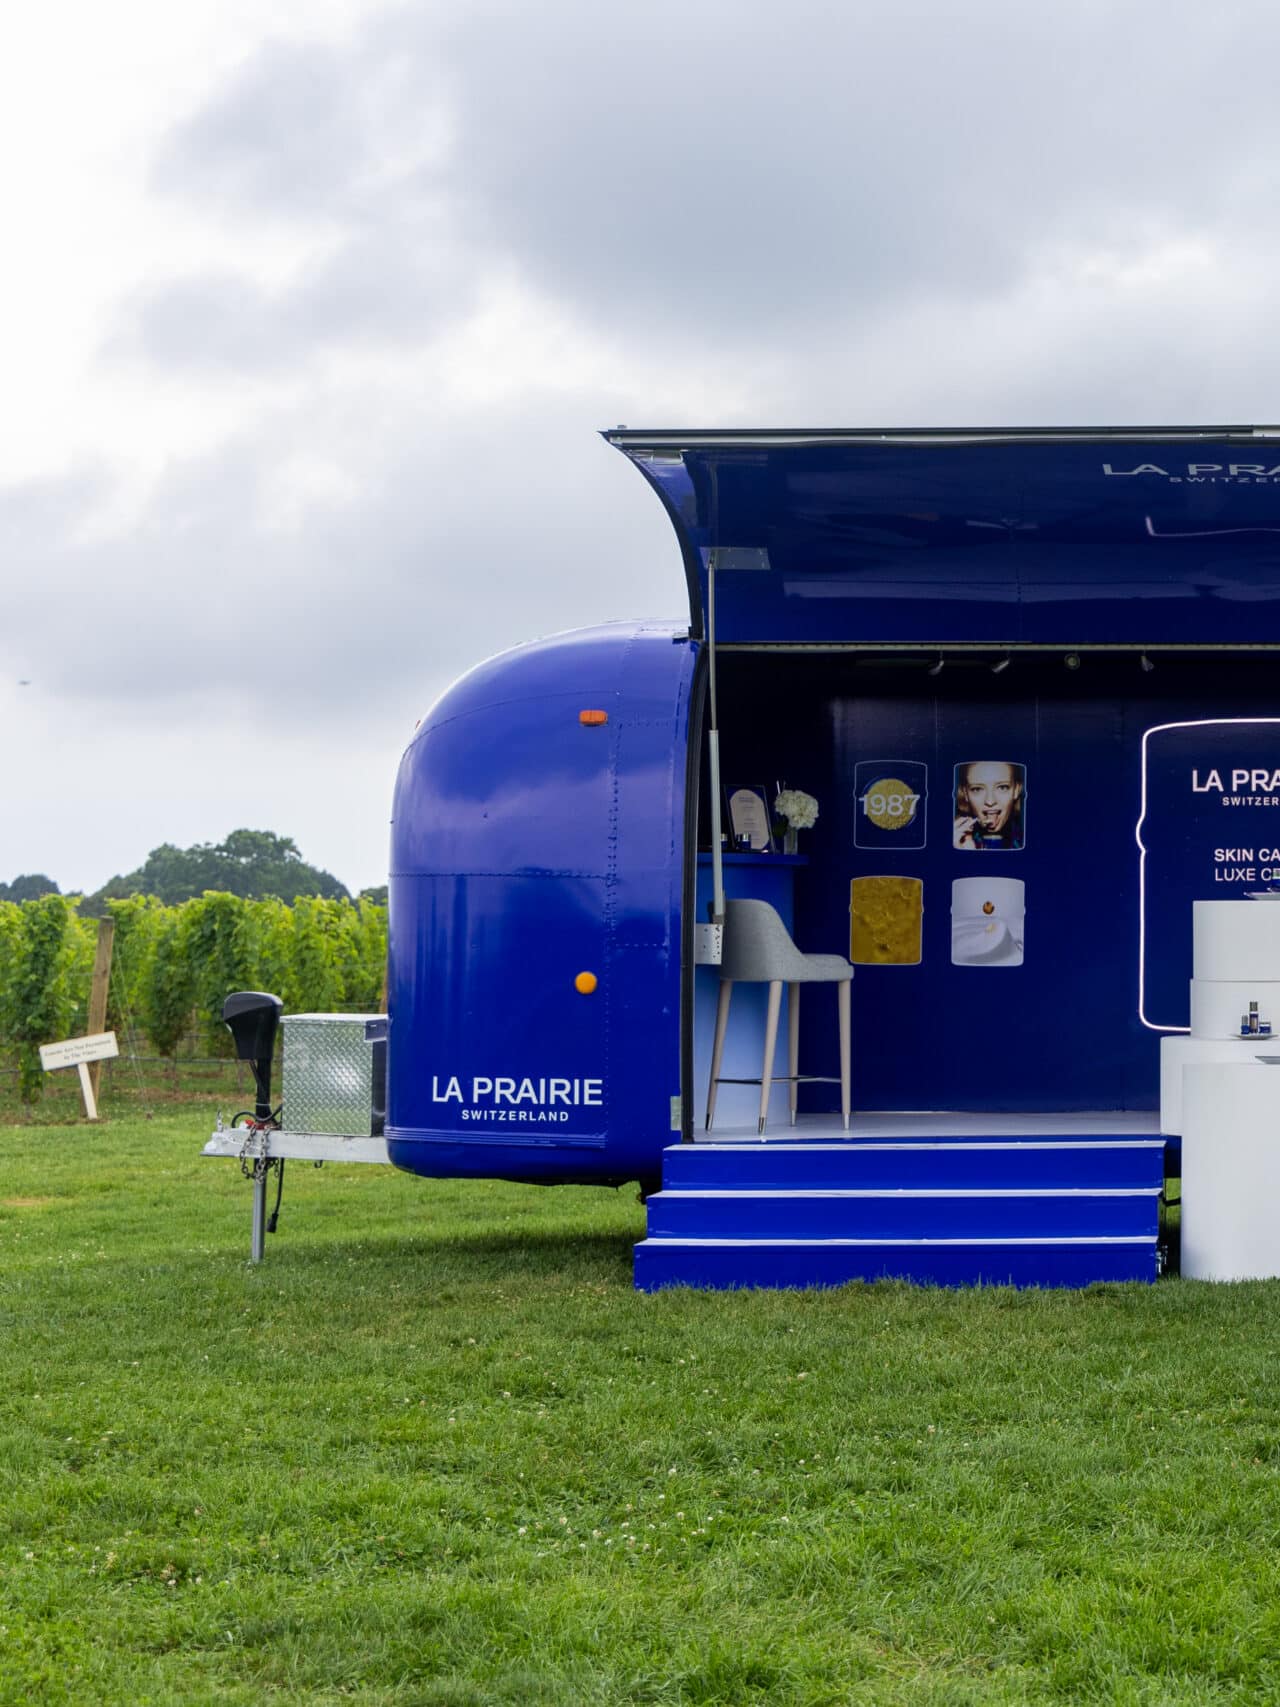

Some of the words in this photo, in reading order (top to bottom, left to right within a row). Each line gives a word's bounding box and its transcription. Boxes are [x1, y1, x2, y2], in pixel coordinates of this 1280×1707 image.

[1102, 463, 1169, 476] LA
[1192, 769, 1224, 792] LA
[859, 794, 921, 816] 1987
[1214, 848, 1254, 862] SKIN
[1214, 867, 1256, 881] LUXE
[432, 1076, 464, 1103] LA
[472, 1077, 603, 1106] PRAIRIE
[461, 1109, 569, 1122] SWITZERLAND
